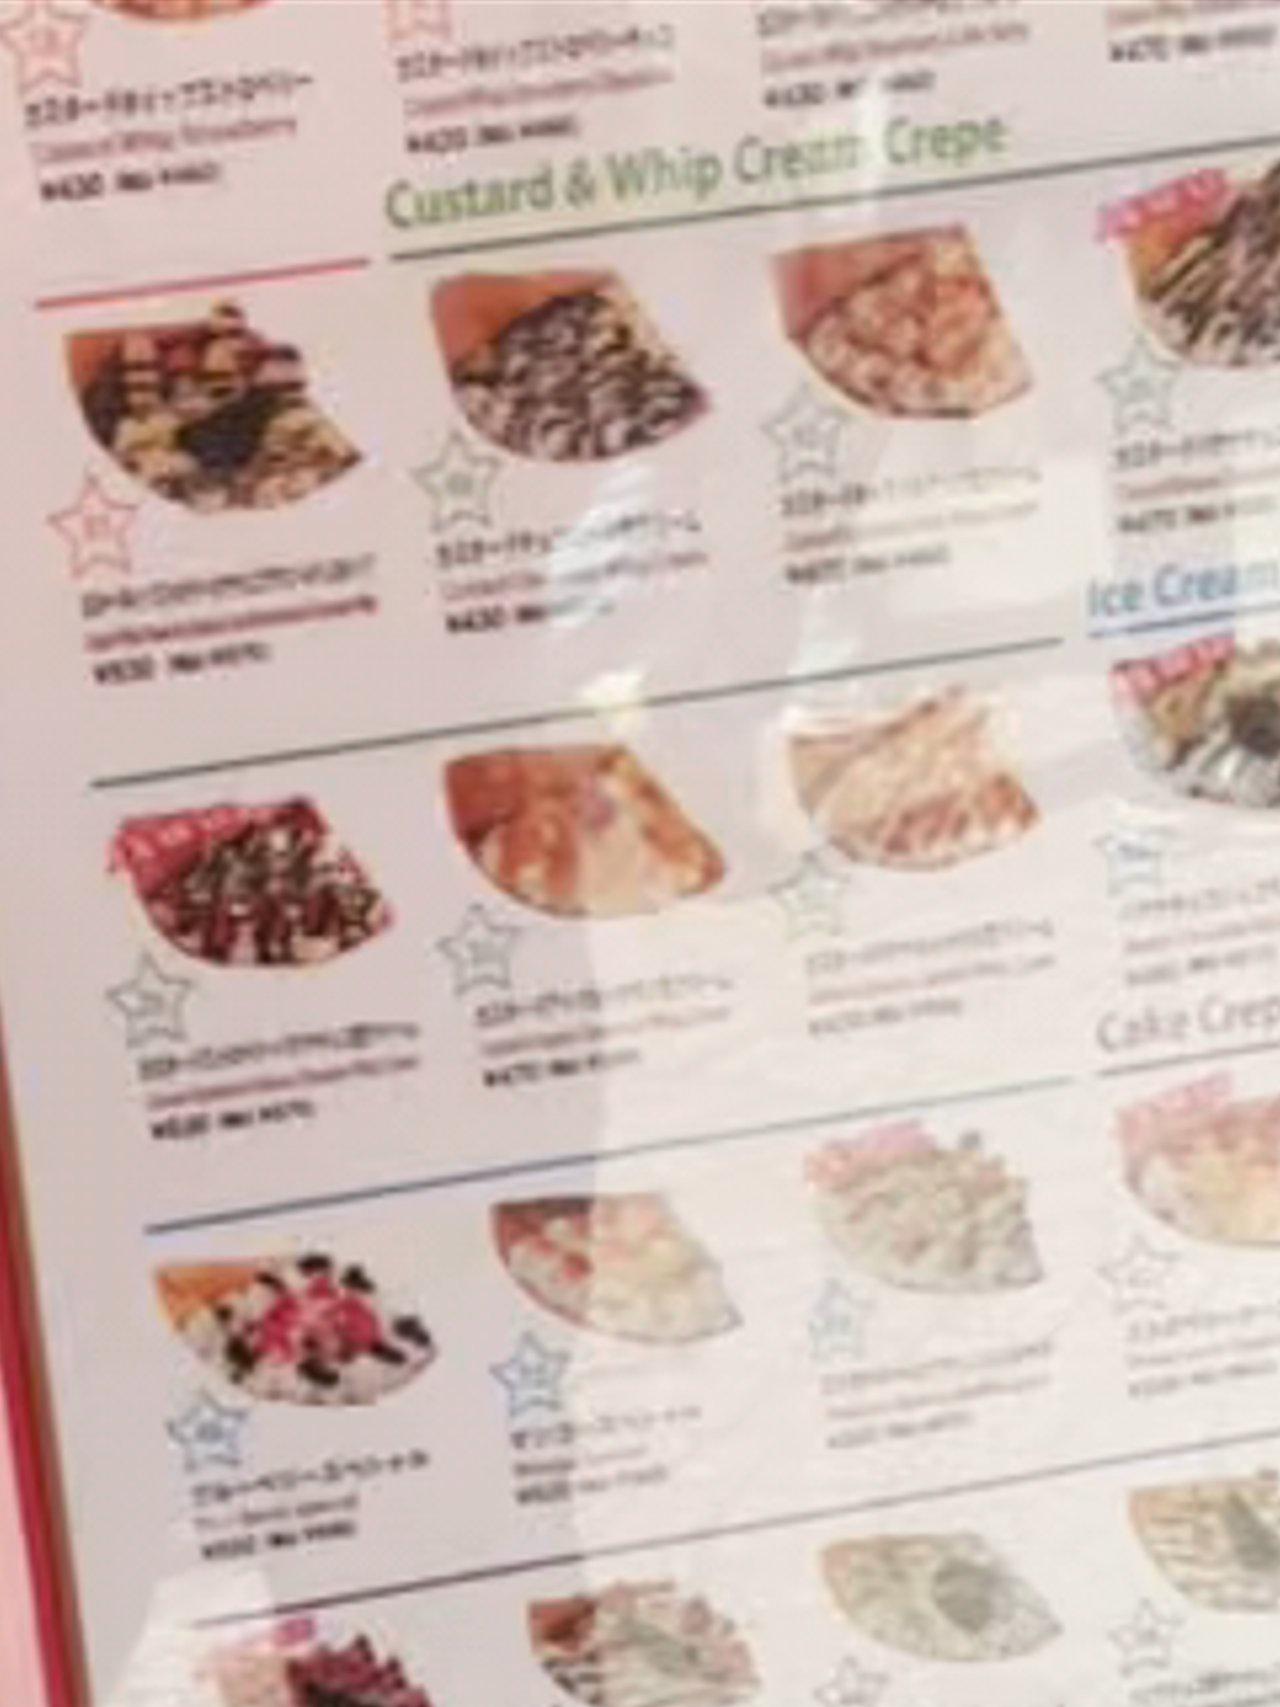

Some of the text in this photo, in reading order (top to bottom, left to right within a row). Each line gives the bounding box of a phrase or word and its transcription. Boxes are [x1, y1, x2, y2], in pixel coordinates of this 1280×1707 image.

[384, 115, 1010, 229] Custard & Whip Cream Crepe
[1087, 576, 1145, 618] Ice
[1153, 559, 1280, 608] Cream
[1095, 1005, 1191, 1053] Cake
